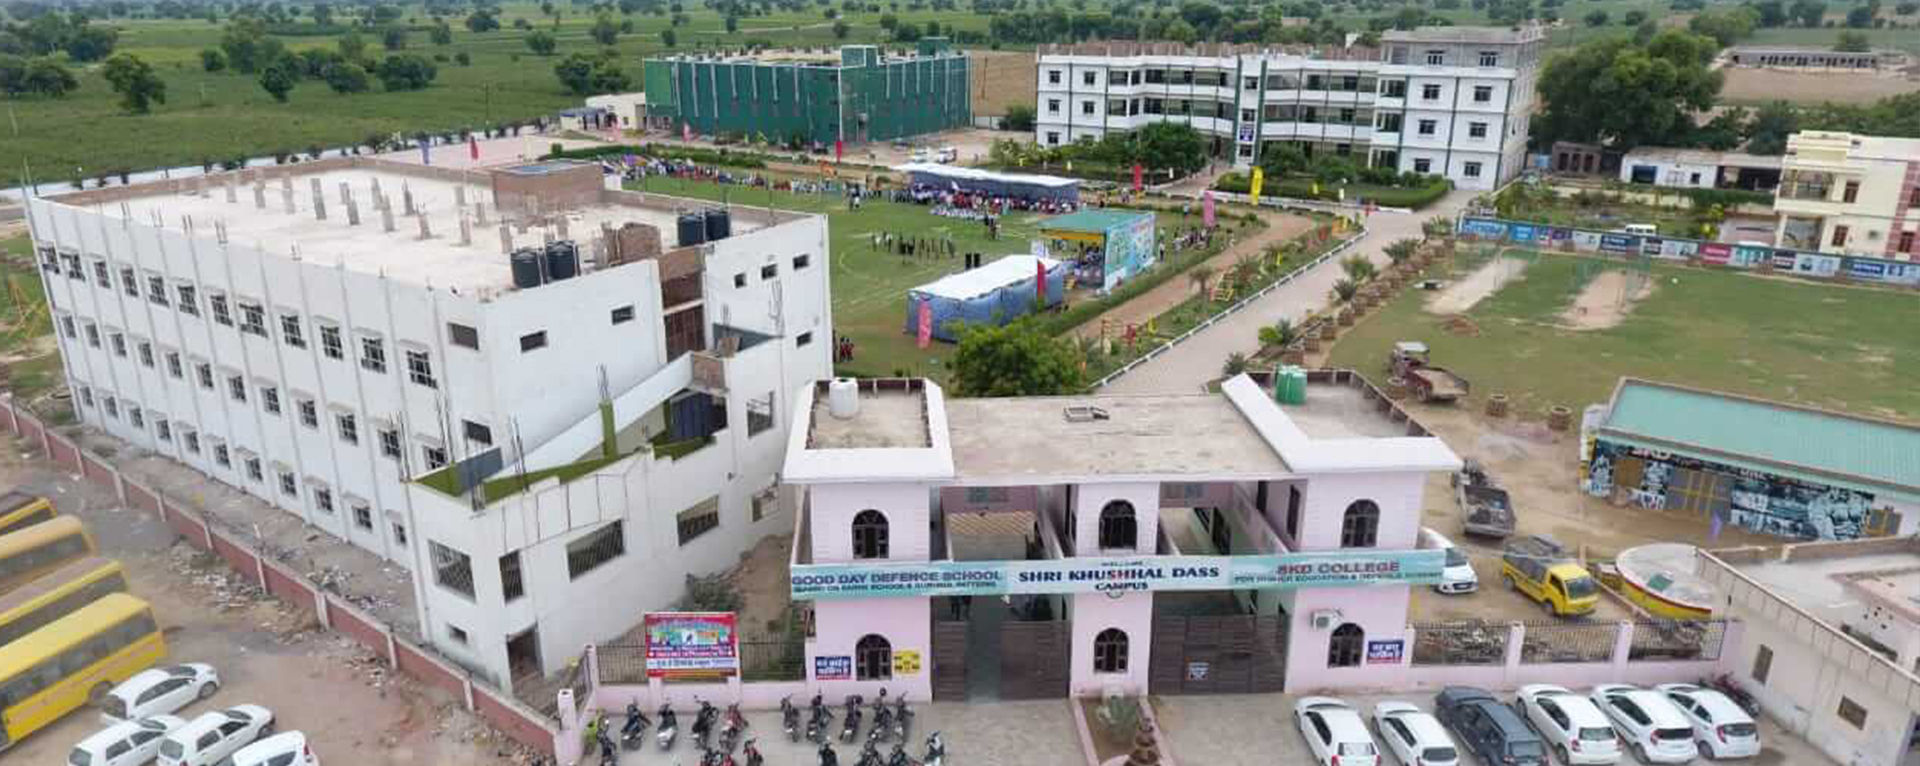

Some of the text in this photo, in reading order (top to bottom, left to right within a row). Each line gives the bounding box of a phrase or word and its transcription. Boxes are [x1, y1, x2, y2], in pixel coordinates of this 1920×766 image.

[1277, 563, 1312, 574] SKD
[1317, 560, 1400, 574] COLLEGE
[792, 570, 1001, 585] GOOD DAY DEFENCE SCHOOL
[1019, 567, 1219, 582] SHRI KHUSHHAL DASS
[1095, 582, 1149, 591] CAMPUS
